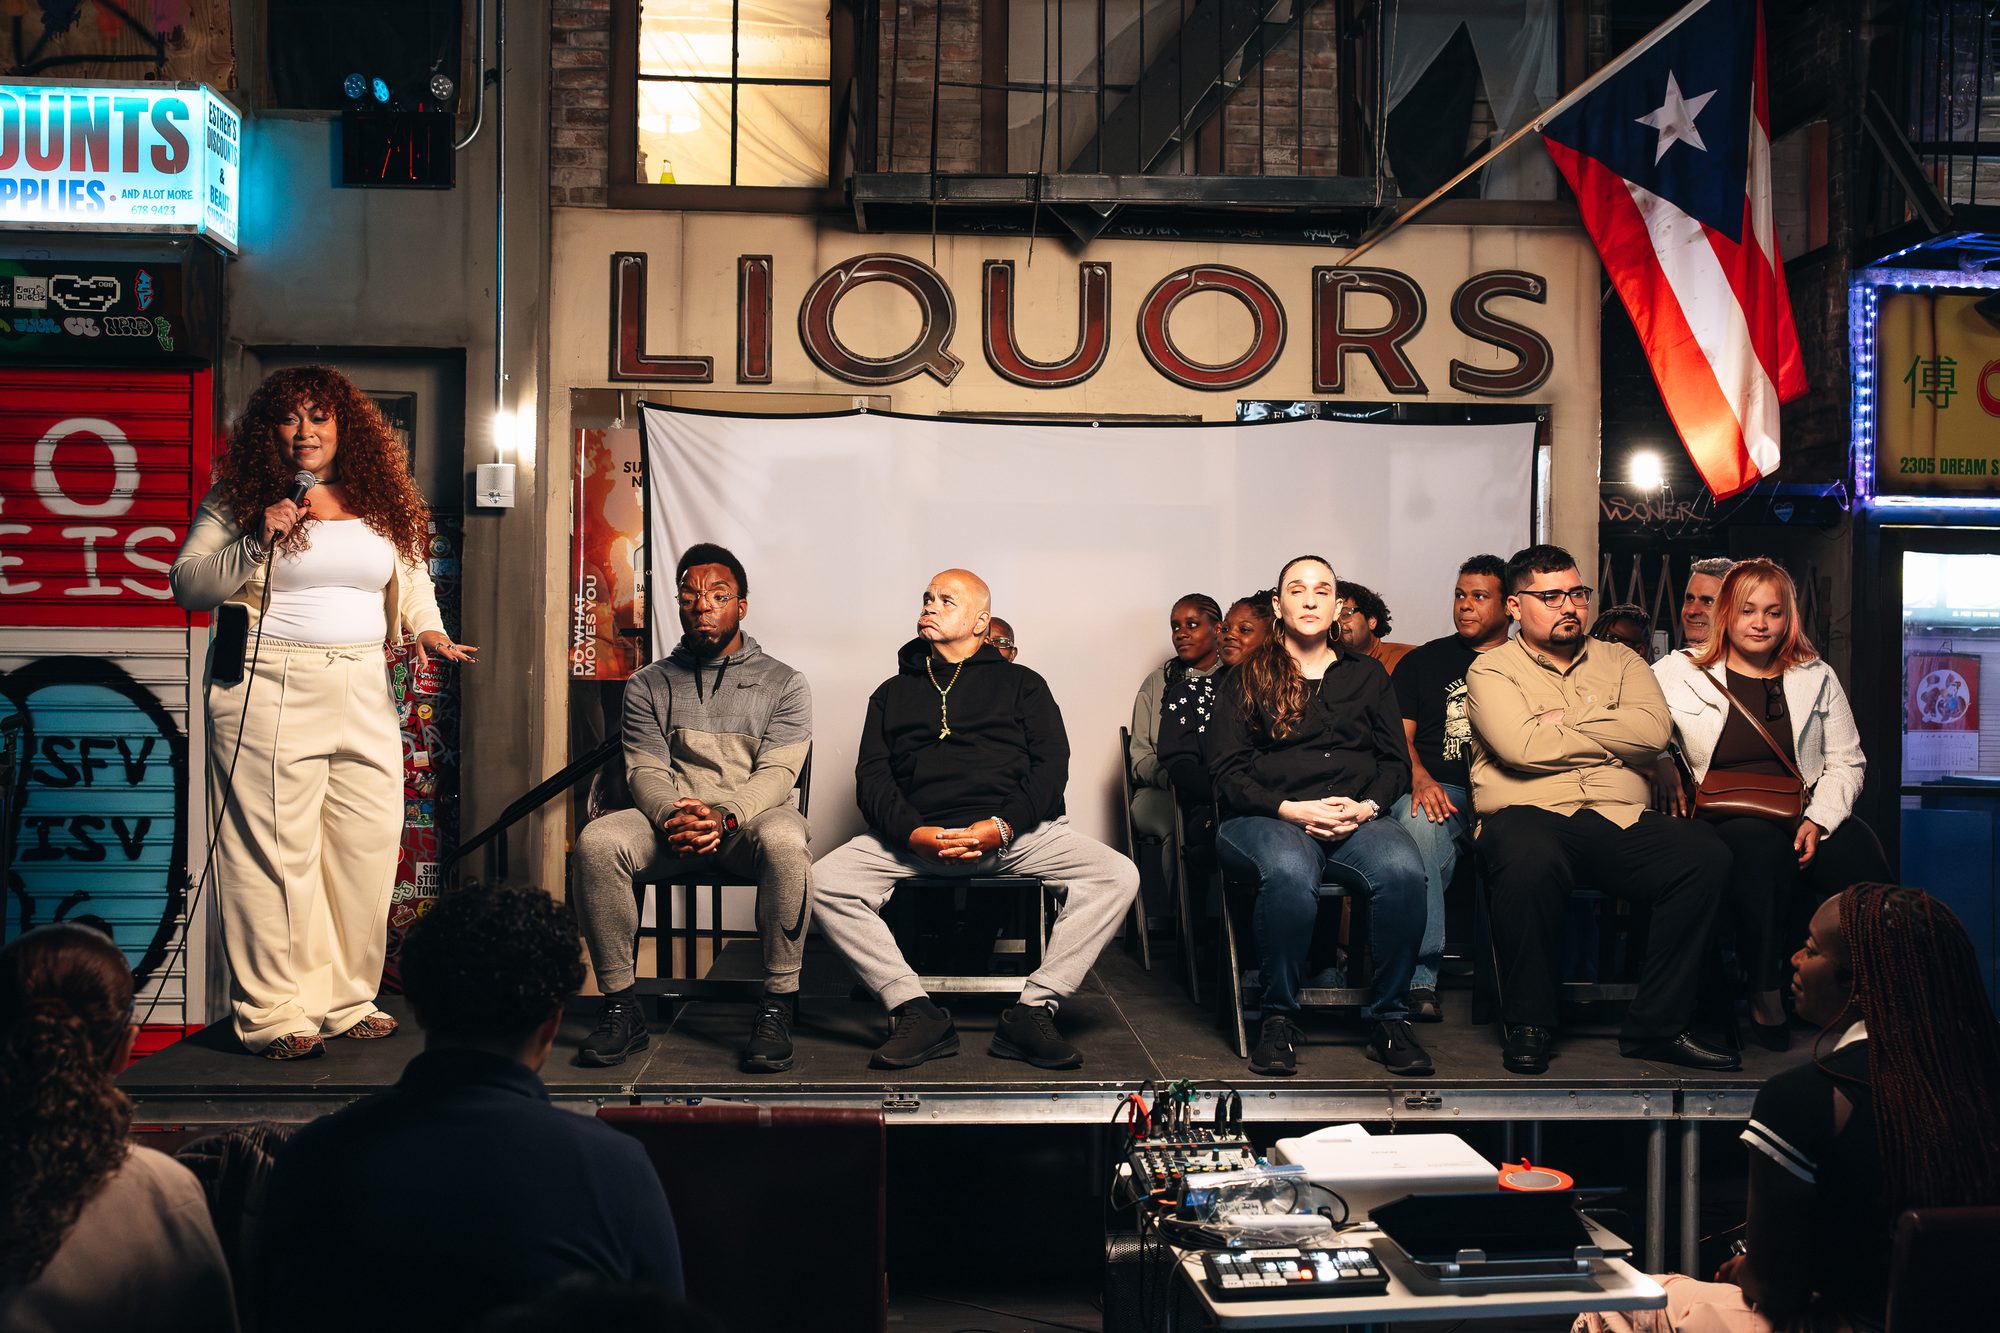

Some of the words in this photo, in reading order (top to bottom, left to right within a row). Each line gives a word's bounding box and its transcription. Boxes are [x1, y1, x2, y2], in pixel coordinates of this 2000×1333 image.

[209, 101, 237, 142] ESTHER'S
[207, 125, 238, 168] DISCOUNTS
[121, 189, 140, 199] AND
[142, 189, 165, 200] ALOT
[167, 190, 193, 200] MORE
[219, 168, 225, 185] &
[131, 205, 148, 215] 678
[151, 205, 176, 215] 9423
[609, 250, 1555, 398] LIQUORS
[0, 417, 141, 517] O
[1900, 457, 1936, 474] 2305
[1940, 458, 1987, 475] DREAM
[585, 575, 598, 611] YOU
[573, 593, 586, 649] WHAT
[573, 649, 585, 676] DO
[585, 613, 597, 676] MOVES
[1444, 678, 1465, 693] LIVE
[33, 736, 155, 787] SFV
[21, 815, 152, 861] ISV
